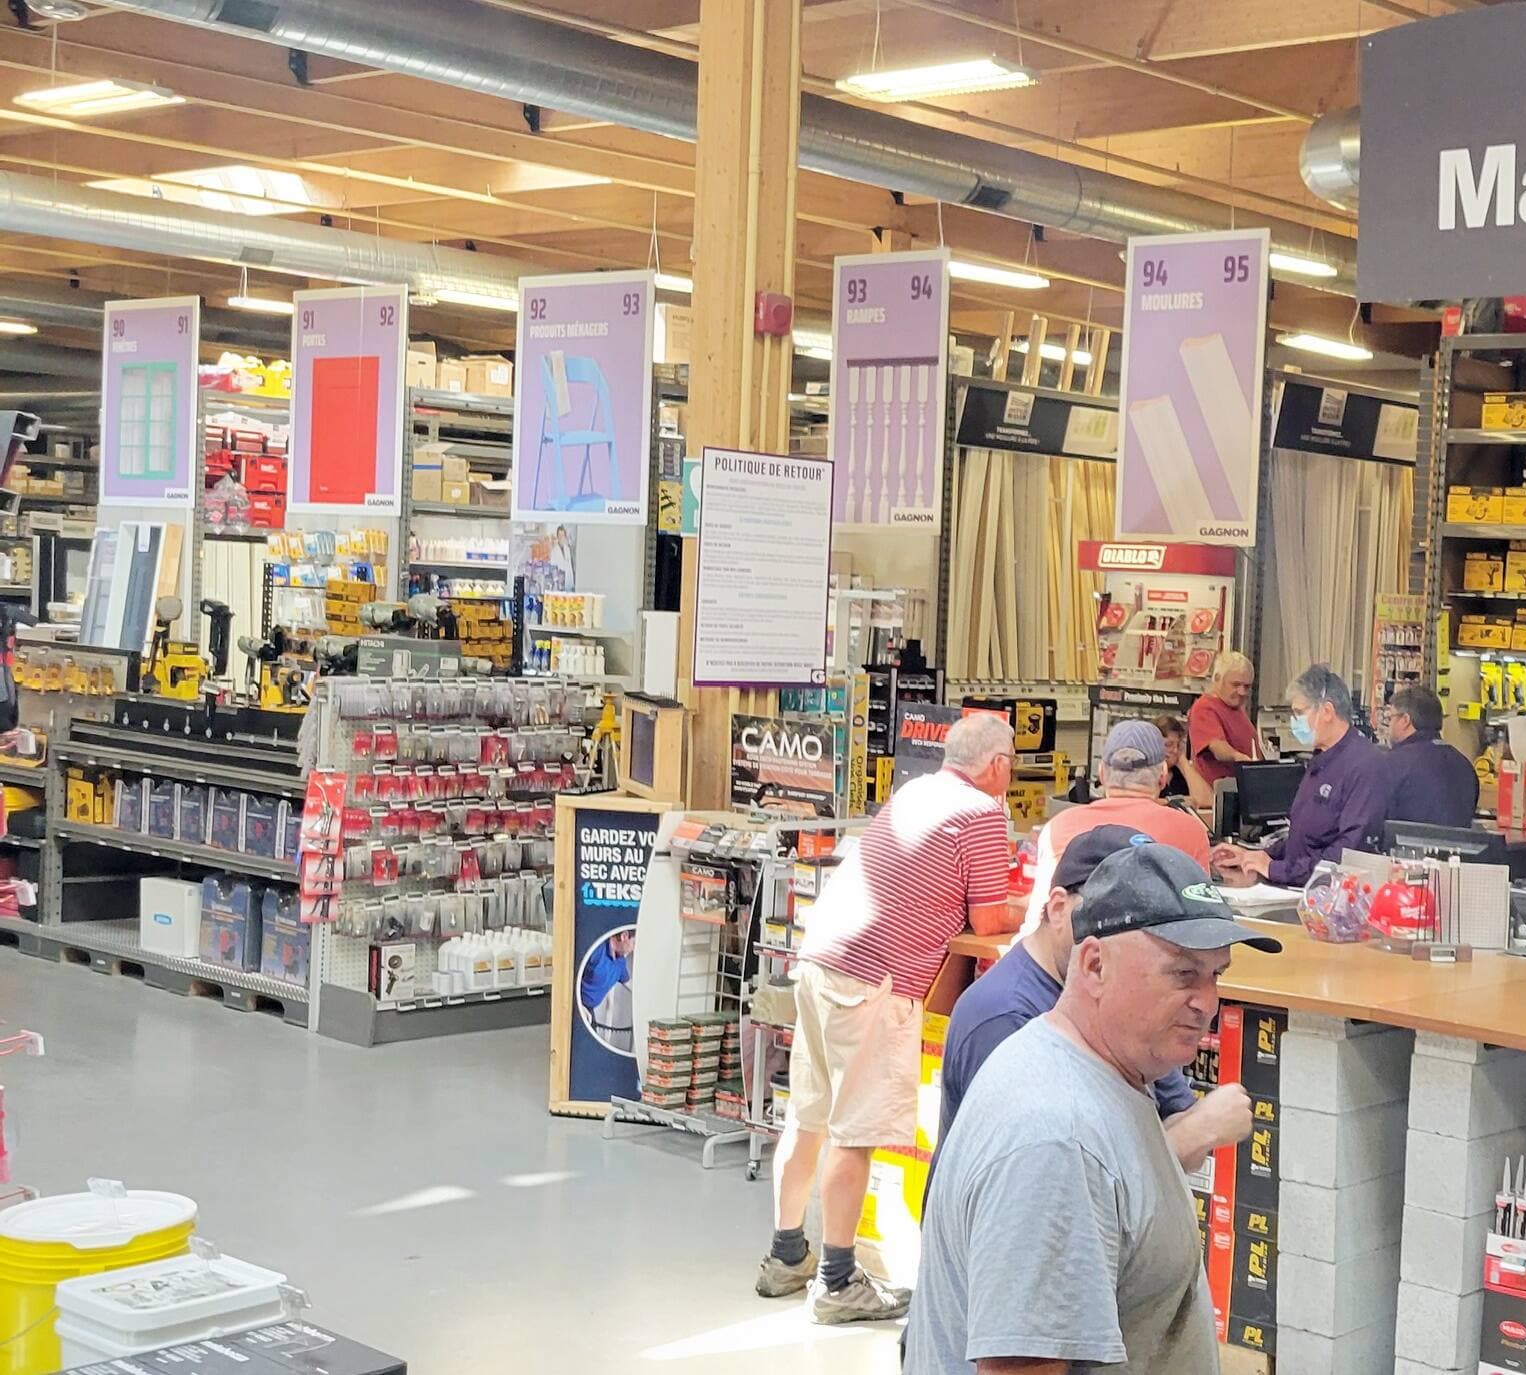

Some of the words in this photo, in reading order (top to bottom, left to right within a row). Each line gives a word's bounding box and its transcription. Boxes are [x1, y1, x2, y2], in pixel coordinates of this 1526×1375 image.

[1142, 260, 1169, 288] 94
[1223, 255, 1250, 284] 95
[847, 279, 867, 303] 93
[910, 275, 933, 300] 94
[530, 299, 547, 320] 92
[623, 293, 640, 316] 93
[1141, 292, 1204, 311] MOULURES
[178, 316, 189, 334] 91
[303, 311, 315, 329] 91
[380, 306, 394, 326] 92
[847, 307, 886, 324] RAMPES
[113, 319, 125, 336] 90
[530, 322, 566, 339] PRODUITS
[567, 319, 609, 338] MÉNAGERS
[714, 457, 766, 475] POLITIQUE
[768, 463, 781, 477] DE
[607, 506, 640, 515] GAGNON
[893, 513, 935, 523] GAGNON
[1199, 526, 1250, 538] GAGNON
[1102, 548, 1147, 564] DIABLO
[903, 711, 926, 722] CAMO
[741, 726, 823, 762] CAMO
[855, 755, 864, 811] Organiser
[581, 828, 636, 846] GARDEZ
[638, 830, 657, 848] VO
[581, 846, 622, 863] MURS
[624, 848, 644, 864] AU
[580, 863, 608, 880] SEC
[610, 865, 647, 881] AVEC
[691, 866, 715, 877] CAMO
[591, 882, 642, 901] TEKS
[727, 880, 737, 913] CAMO
[1257, 1016, 1276, 1053] PL
[1254, 1101, 1275, 1122] PL
[1251, 1128, 1271, 1167] PL
[1248, 1212, 1269, 1233] PL
[1248, 1240, 1268, 1278] PL
[1243, 1325, 1264, 1345] PL
